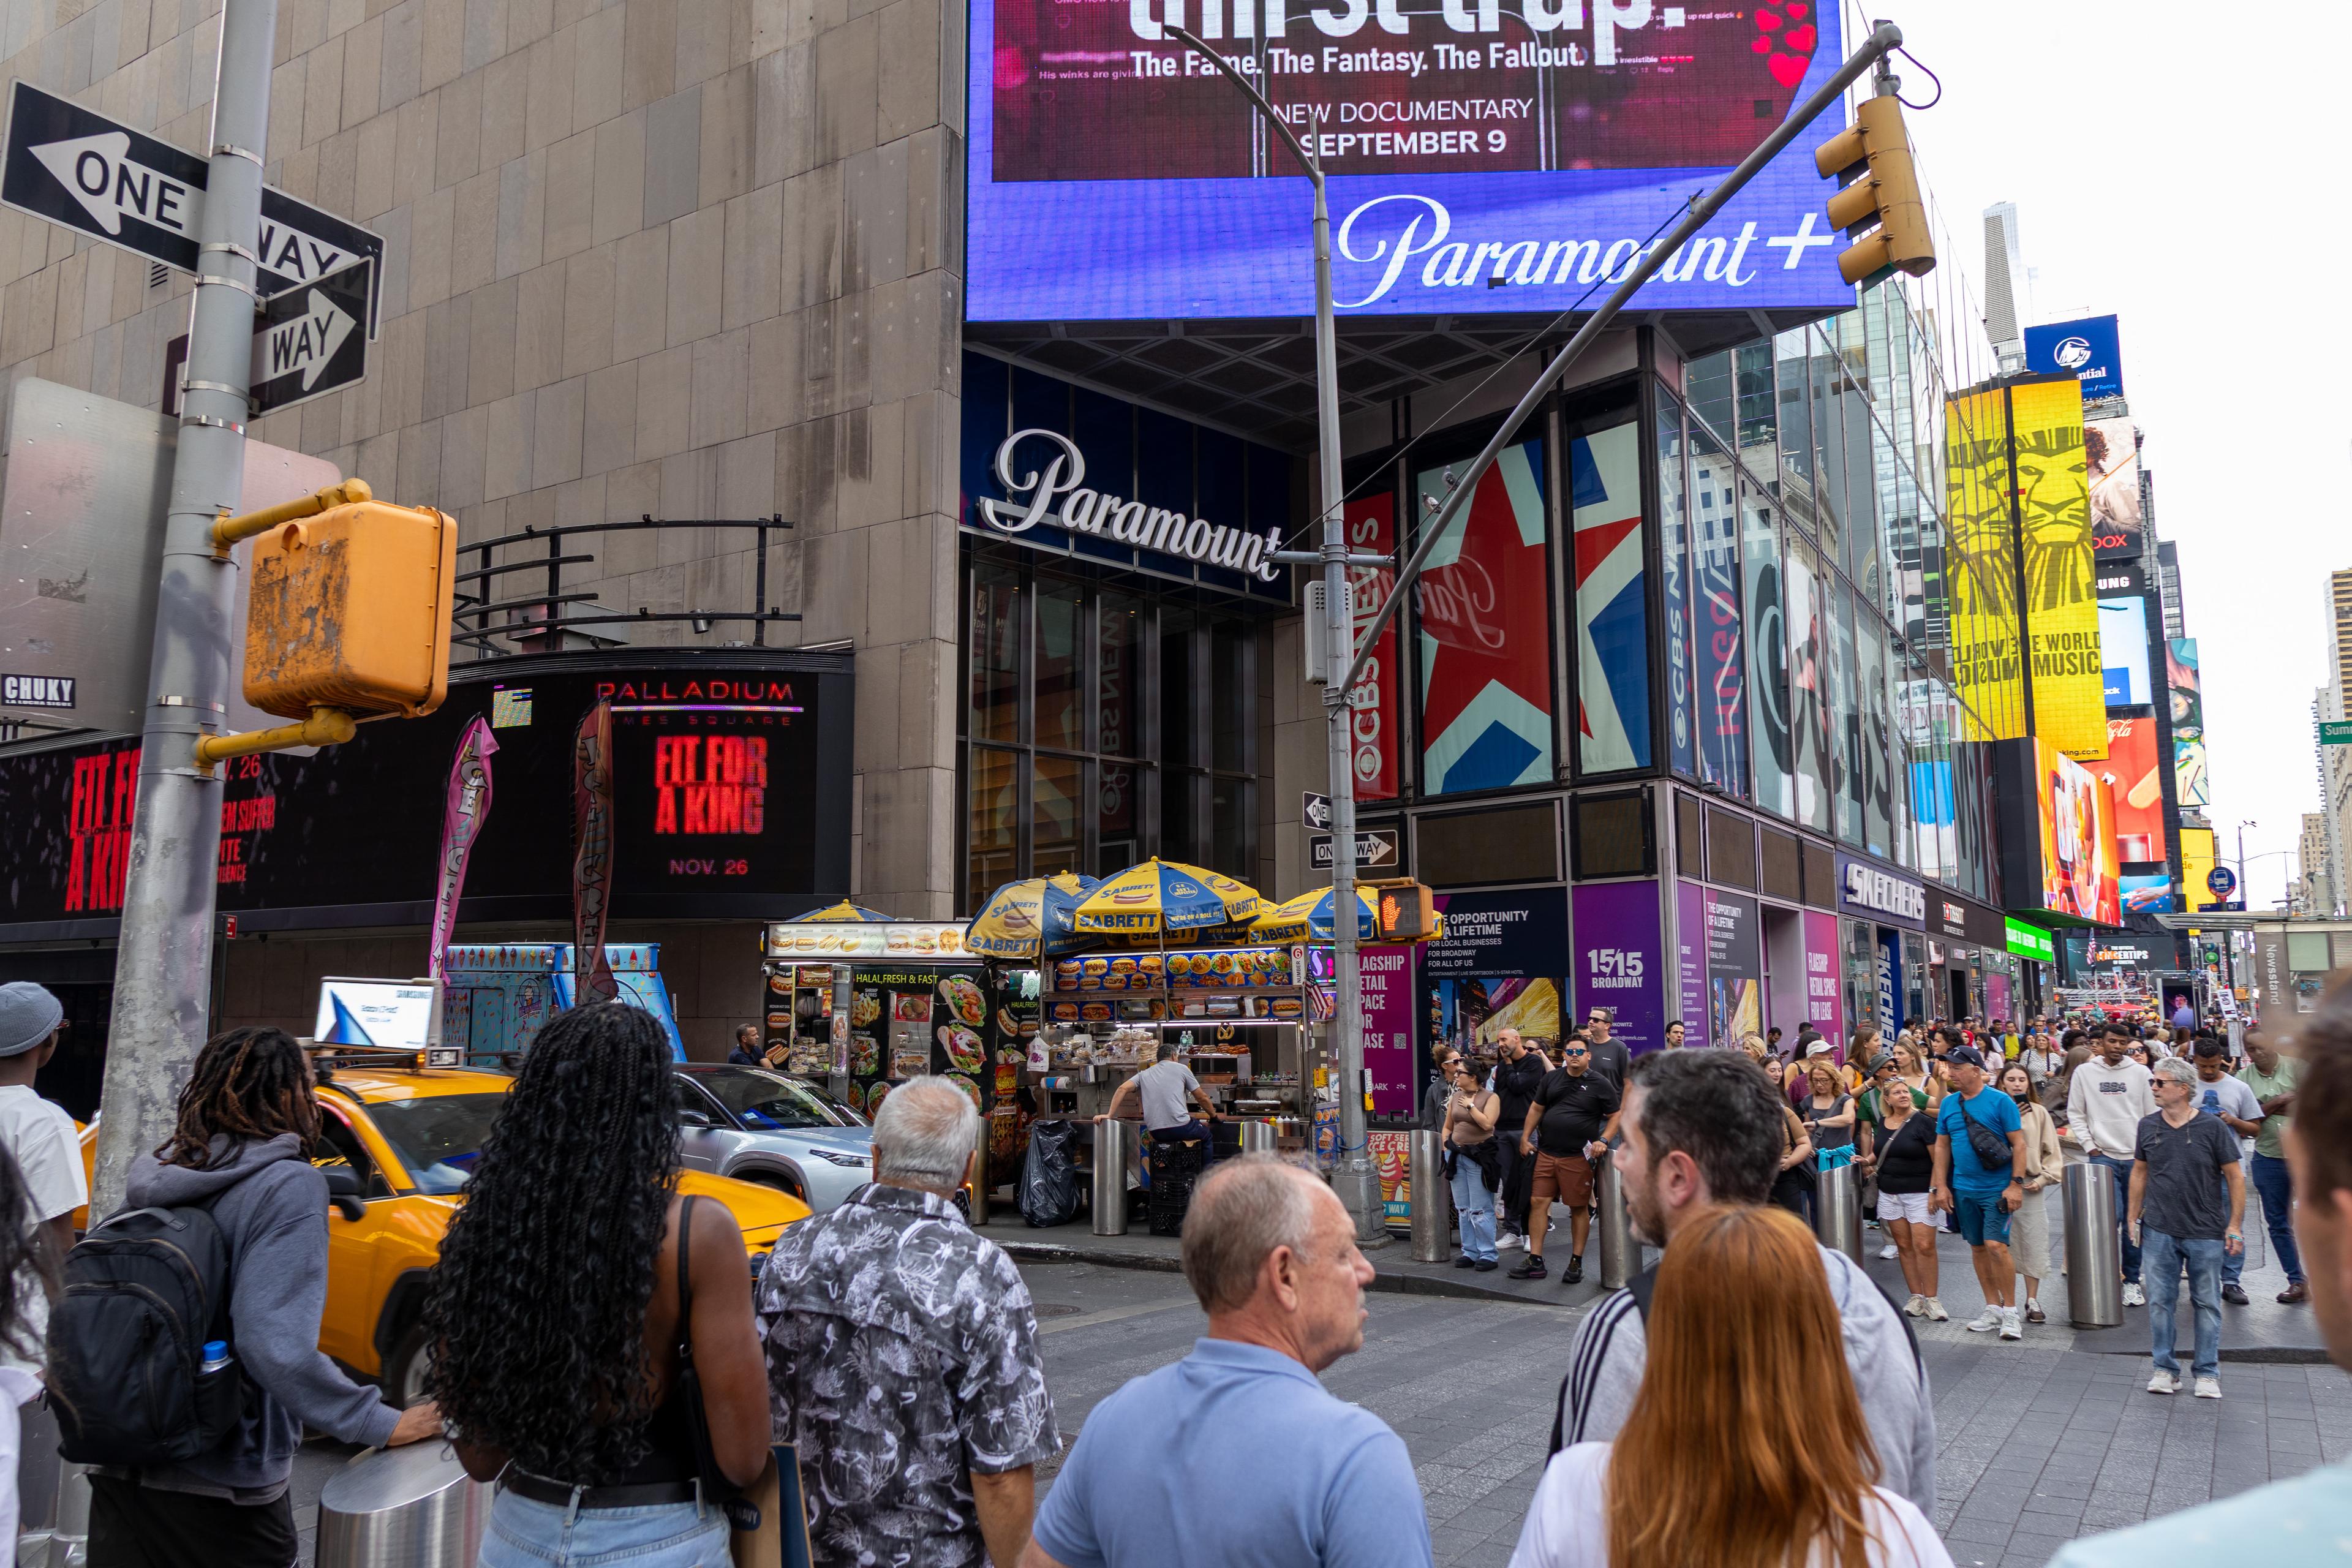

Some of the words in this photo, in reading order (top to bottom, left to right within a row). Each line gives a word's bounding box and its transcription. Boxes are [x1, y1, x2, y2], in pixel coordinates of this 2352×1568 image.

[1714, 12, 1735, 20] quick
[1129, 51, 1176, 77] The
[1267, 47, 1319, 74] The
[1322, 45, 1428, 78] Fantasy.
[1433, 43, 1483, 71] The
[1489, 40, 1585, 69] Fallout.
[1039, 71, 1057, 80] His
[1059, 70, 1090, 79] winks
[1273, 103, 1331, 124] NEW
[1340, 98, 1533, 123] DOCUMENTARY
[1300, 130, 1478, 157] SEPTEMBER
[1488, 130, 1507, 153] 9
[75, 150, 186, 230] ONE
[273, 310, 335, 374] WAY
[980, 429, 1282, 582] Paramount
[1351, 517, 1379, 649] NEWS
[1669, 612, 1686, 704] CBS
[2033, 650, 2103, 677] MUSIC
[5, 677, 73, 701] CHUKY
[595, 682, 794, 701] PALLADIUM
[1354, 654, 1381, 746] CBS
[612, 715, 669, 726] IMES
[239, 753, 261, 779] 26
[655, 735, 701, 789] FIT
[706, 735, 769, 789] FOR
[456, 731, 489, 818] ICE
[70, 754, 111, 840] FIT
[111, 748, 142, 828] FO
[238, 796, 276, 831] SUFFER
[654, 784, 677, 835] A
[683, 785, 766, 835] KING
[1312, 804, 1327, 820] ONE
[1319, 845, 1333, 859] ON
[1356, 842, 1381, 856] WAY
[65, 836, 85, 911] A
[89, 831, 134, 910] KI
[669, 859, 718, 876] NOV.
[724, 859, 749, 875] 26
[1099, 884, 1156, 899] SABRETT
[1846, 863, 1926, 921] SKECHERS
[990, 901, 1039, 918] SABRETT
[1450, 910, 1529, 925] OPPORTUNITY
[1078, 912, 1158, 928] SABRETT
[1250, 922, 1306, 943] SABRETT
[1445, 925, 1452, 937] A
[1453, 924, 1502, 937] LIFETIME
[969, 935, 1039, 952] SABRETT
[1463, 938, 1502, 946] BUSINESSES
[1360, 956, 1405, 971] AGSHIP
[908, 974, 916, 984] &
[918, 974, 938, 984] FAST
[1360, 975, 1388, 990] ETAIL
[1592, 976, 1643, 989] BROADWAY
[2266, 944, 2282, 1005] Newsstand
[1360, 995, 1385, 1010] PACE
[1877, 943, 1896, 1058] SKECHER
[1362, 1033, 1384, 1049] ASE
[2099, 1082, 2127, 1093] 1994
[1370, 1133, 1393, 1143] SOFT
[1394, 1134, 1410, 1142] SER
[1387, 1140, 1410, 1152] CRE
[1388, 1204, 1406, 1215] WAY
